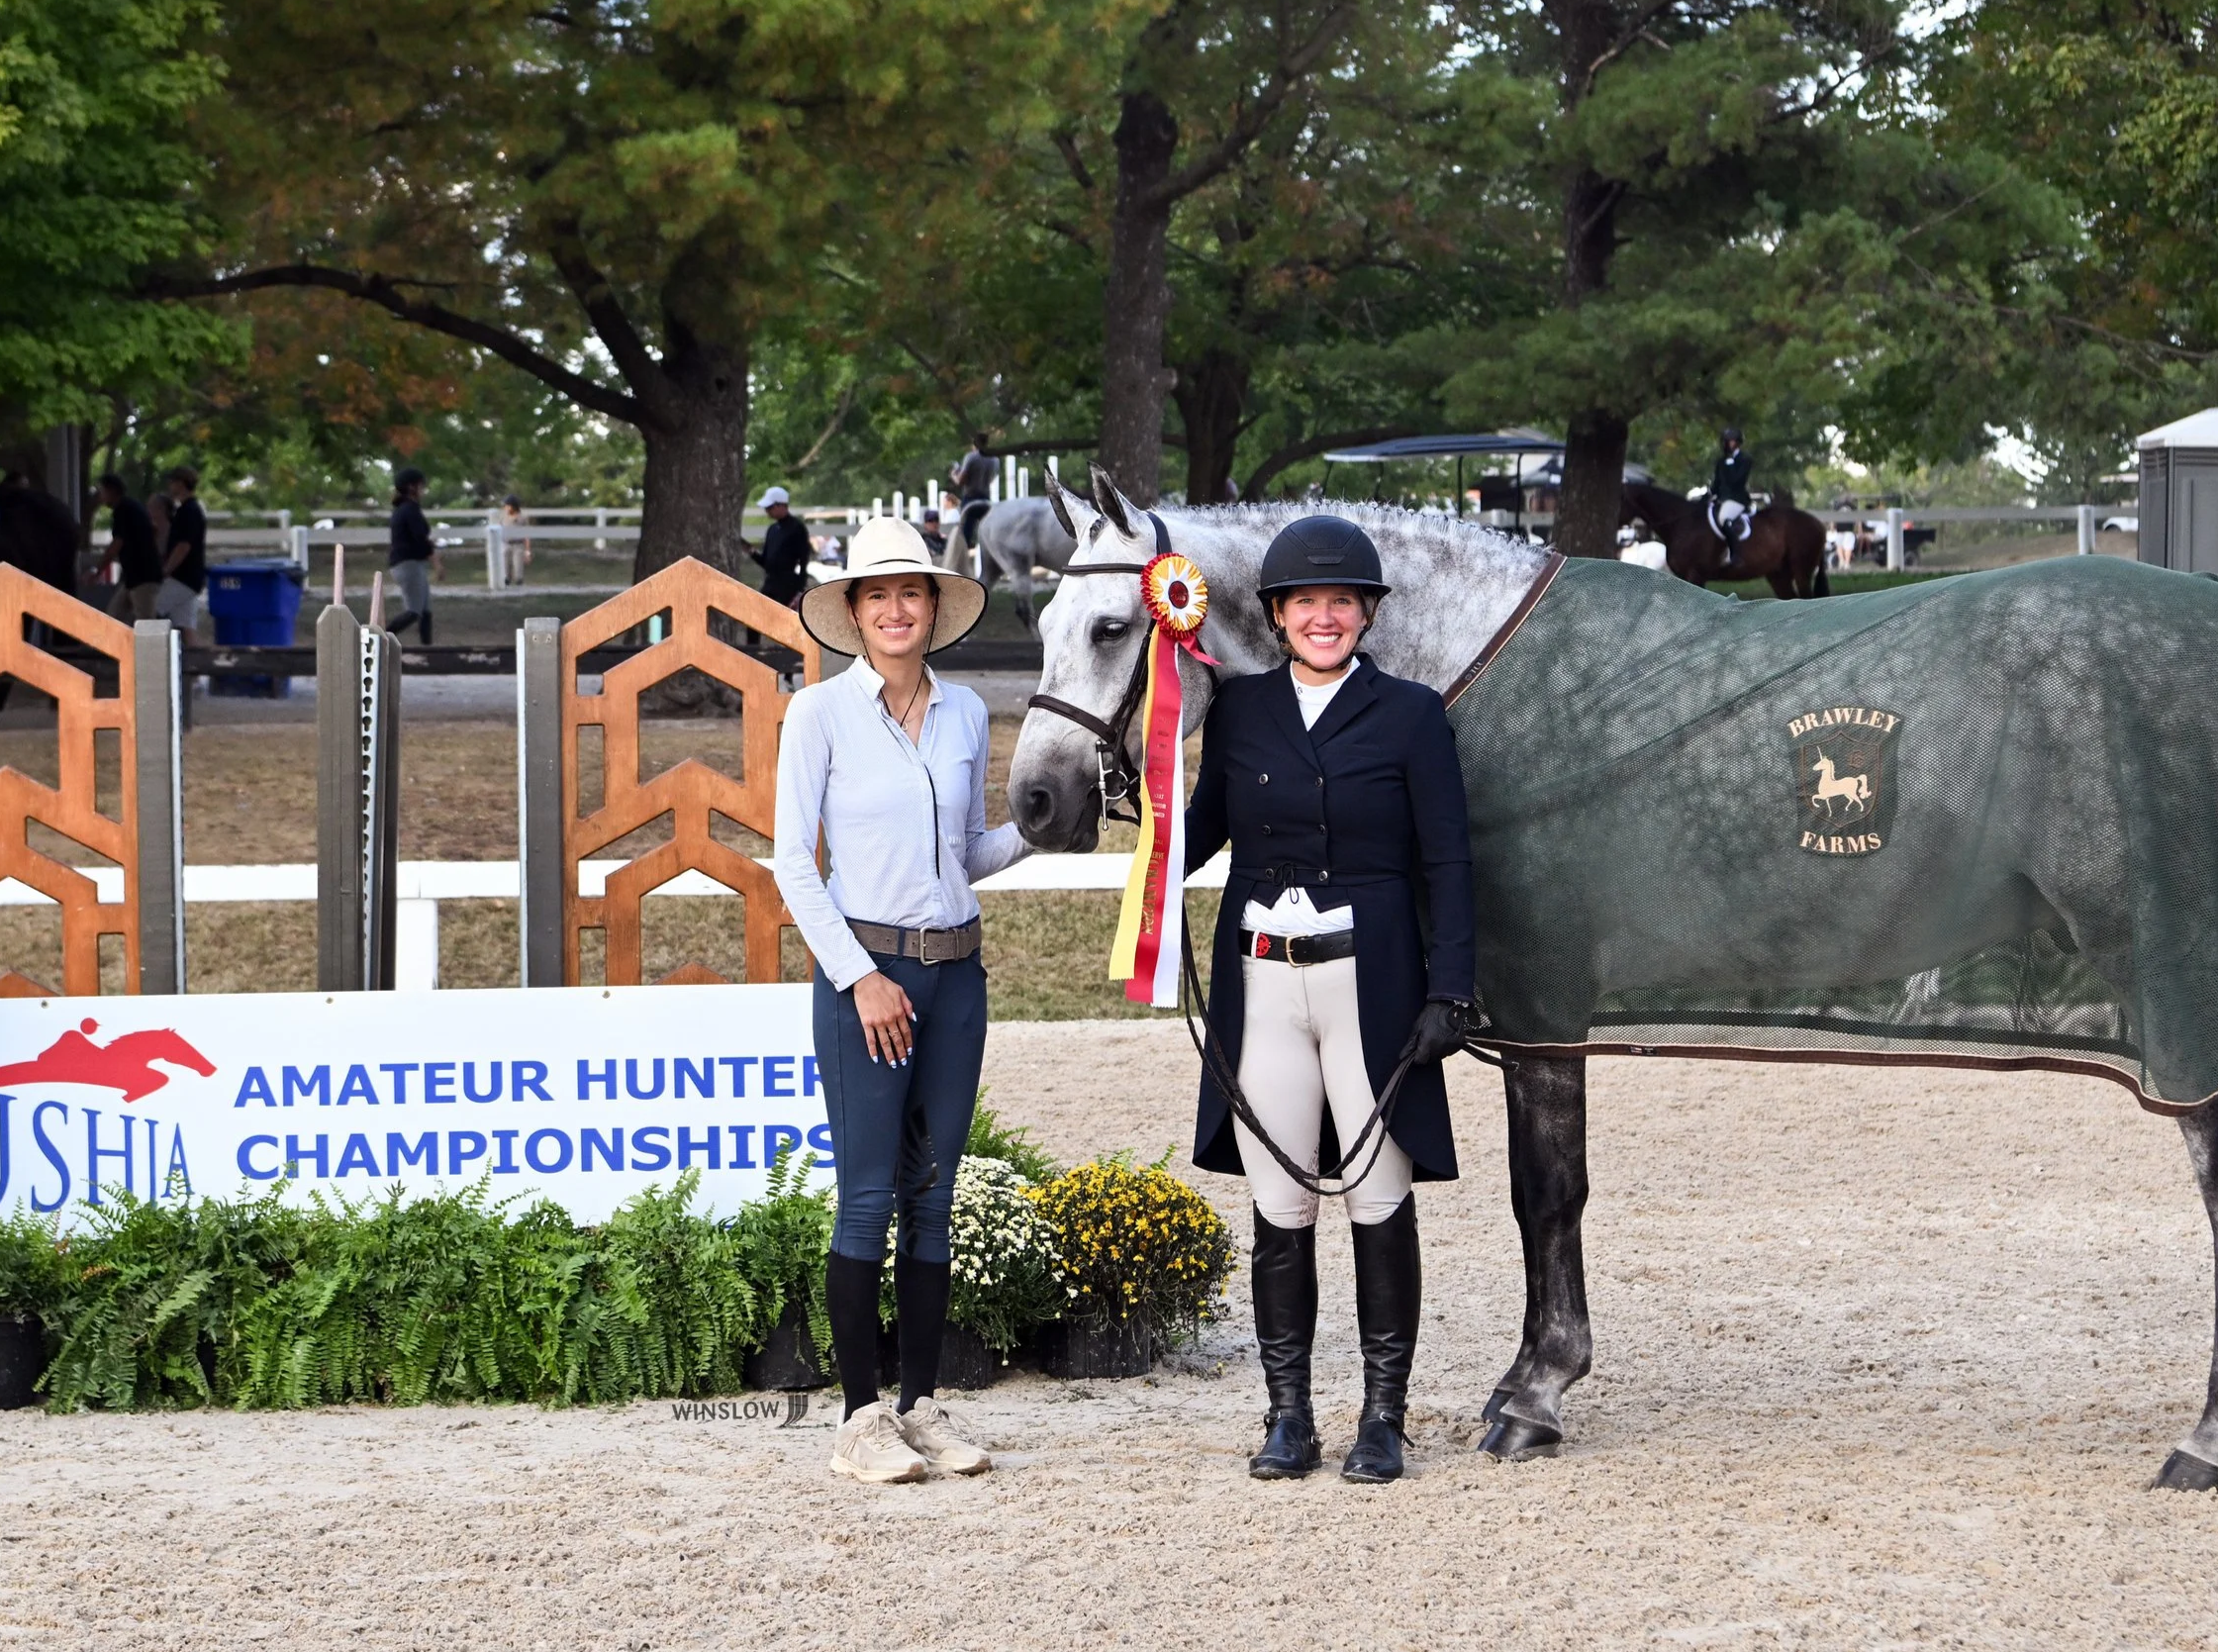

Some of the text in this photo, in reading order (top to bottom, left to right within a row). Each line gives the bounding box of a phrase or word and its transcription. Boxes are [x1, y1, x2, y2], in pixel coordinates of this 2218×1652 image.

[1786, 707, 1901, 737] BRAWLEY
[1150, 851, 1165, 860] ERVE
[1799, 830, 1881, 853] FARMS
[234, 1060, 555, 1108] AMATEUR
[237, 1122, 837, 1181] CHAMPIONSHIPS
